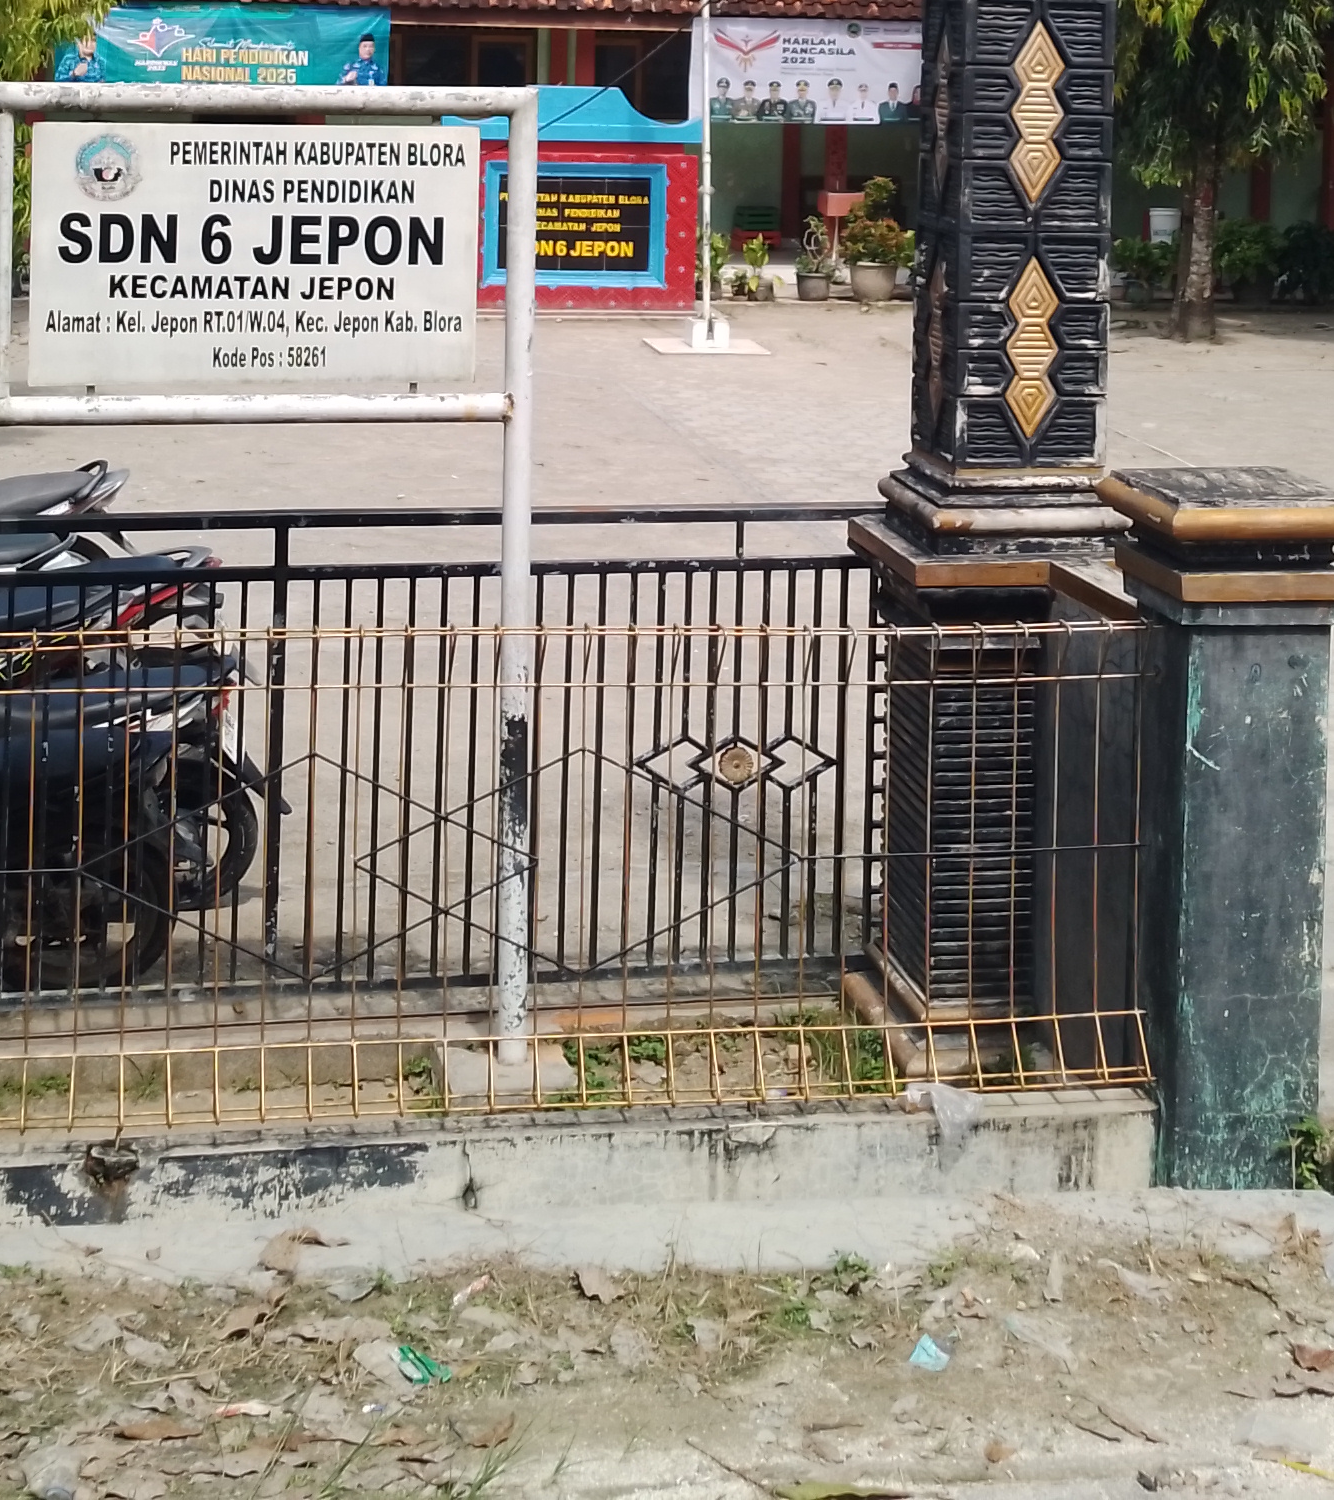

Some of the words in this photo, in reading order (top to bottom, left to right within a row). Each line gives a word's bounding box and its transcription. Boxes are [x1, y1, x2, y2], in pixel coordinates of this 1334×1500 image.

[782, 37, 837, 46] HARLAH
[182, 48, 216, 62] HARI
[221, 49, 309, 66] PENDIDIKAN
[782, 46, 856, 56] PANCASILA
[781, 56, 815, 64] 2025
[181, 66, 251, 82] NASIONAL
[170, 141, 288, 166] PEMERINTAH
[294, 141, 401, 166] KABUPATEN
[407, 142, 466, 167] BLORA
[209, 179, 275, 203] DINAS
[283, 179, 415, 204] PENDIDIKAN
[560, 194, 615, 204] KABUPATEN
[618, 195, 649, 205] BLORA
[535, 208, 558, 217] INAS
[564, 208, 620, 218] PENDIDIKAN
[535, 221, 586, 231] ECAMATAN
[591, 223, 621, 232] JEPON
[57, 212, 178, 264] SDN
[201, 213, 232, 265] 6
[252, 214, 444, 266] JEPON
[555, 240, 567, 257] 6
[569, 240, 634, 257] JEPON
[108, 274, 290, 300] KECAMATAN
[300, 276, 395, 301] JEPON
[45, 309, 101, 333] Alamat
[116, 310, 146, 333] Kel.
[150, 310, 198, 338] Jepon
[295, 311, 328, 333] Kec.
[333, 311, 379, 338] Jepon
[384, 311, 418, 333] Kab.
[423, 311, 462, 333] Blora
[212, 346, 246, 368] Kode
[250, 346, 275, 368] Pos
[287, 346, 326, 368] 58261
